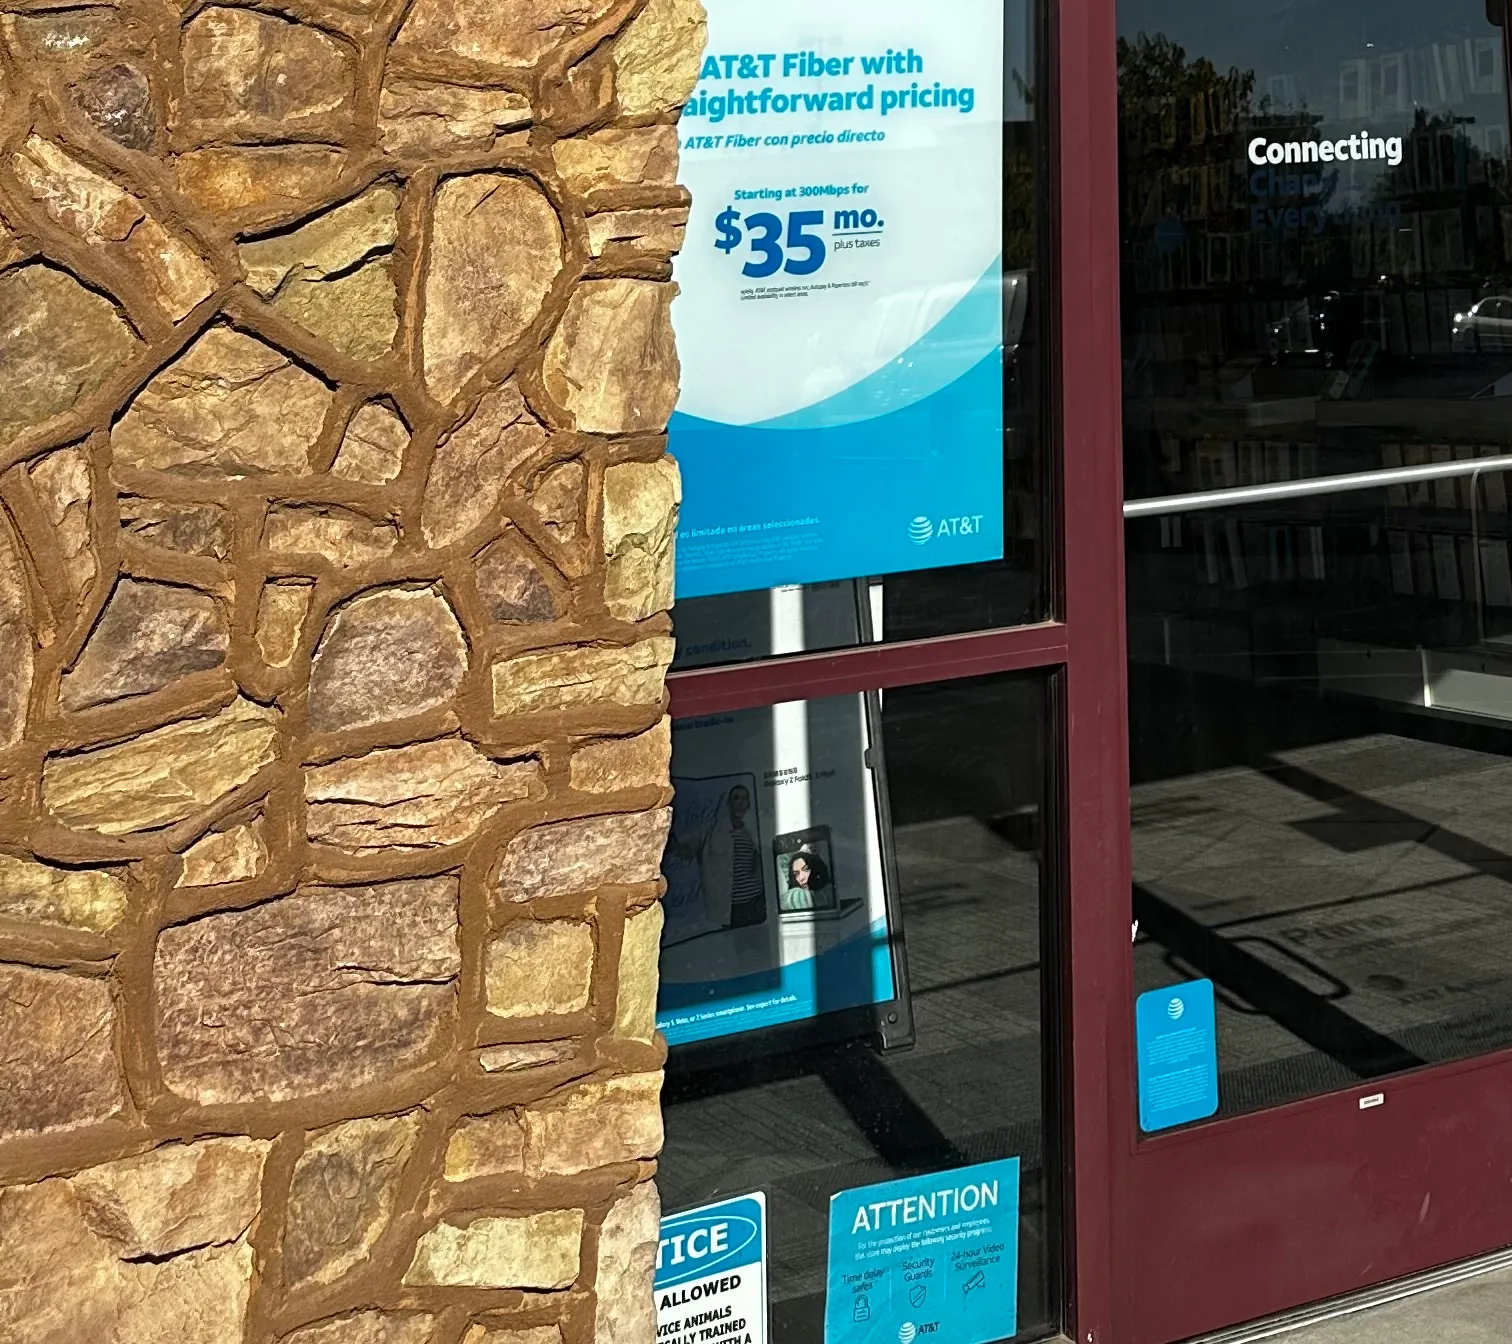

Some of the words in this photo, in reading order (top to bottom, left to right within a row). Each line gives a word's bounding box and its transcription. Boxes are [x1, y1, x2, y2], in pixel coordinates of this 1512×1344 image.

[700, 53, 776, 80] AT&T
[783, 51, 855, 77] Fiber
[860, 48, 923, 75] with
[683, 84, 874, 123] aightforward
[880, 82, 975, 116] pricing
[684, 136, 724, 150] AT&T
[725, 134, 761, 148] Fiber
[764, 136, 789, 146] con
[790, 130, 834, 148] precio
[837, 129, 886, 144] directo
[1248, 130, 1403, 166] Connecting
[734, 188, 783, 201] Starting
[785, 187, 796, 198] at
[799, 184, 850, 198] 300Mbps
[852, 183, 869, 194] for
[834, 208, 885, 230] mo.
[714, 205, 827, 279] $35
[834, 240, 853, 252] plus
[855, 238, 880, 248] taxes
[937, 515, 984, 538] AT&T
[851, 1180, 999, 1235] ATTENTION
[656, 1222, 729, 1270] TICE
[951, 1249, 981, 1262] 24-hour
[983, 1243, 1005, 1254] Video
[902, 1257, 935, 1271] Security
[955, 1254, 1001, 1272] Surveillance
[842, 1272, 864, 1285] Time
[864, 1267, 885, 1280] delay
[904, 1268, 933, 1282] Guards
[660, 1274, 742, 1311] ALLOWED
[656, 1320, 681, 1338] VICE
[684, 1305, 732, 1330] ANIMALS
[699, 1318, 747, 1341] TRAINED
[917, 1321, 941, 1336] AT&T
